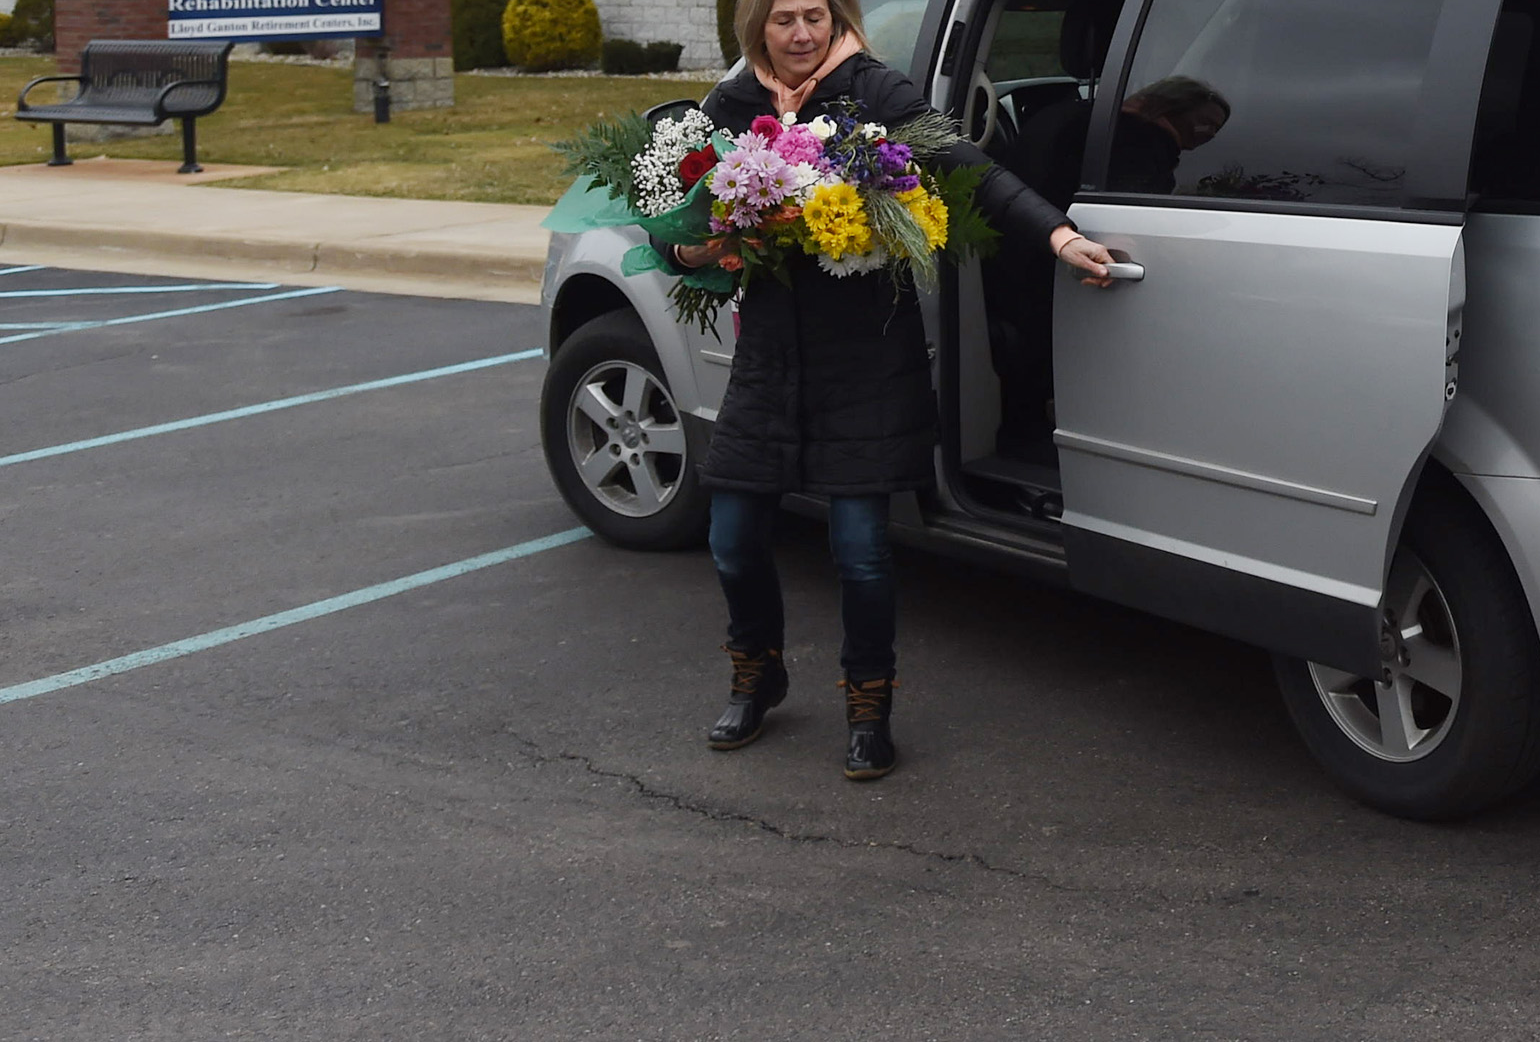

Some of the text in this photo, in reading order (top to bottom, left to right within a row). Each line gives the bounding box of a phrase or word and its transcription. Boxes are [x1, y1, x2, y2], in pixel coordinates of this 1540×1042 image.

[171, 21, 204, 37] Lloyd
[252, 18, 310, 31] Retirement
[357, 16, 377, 27] Inc.
